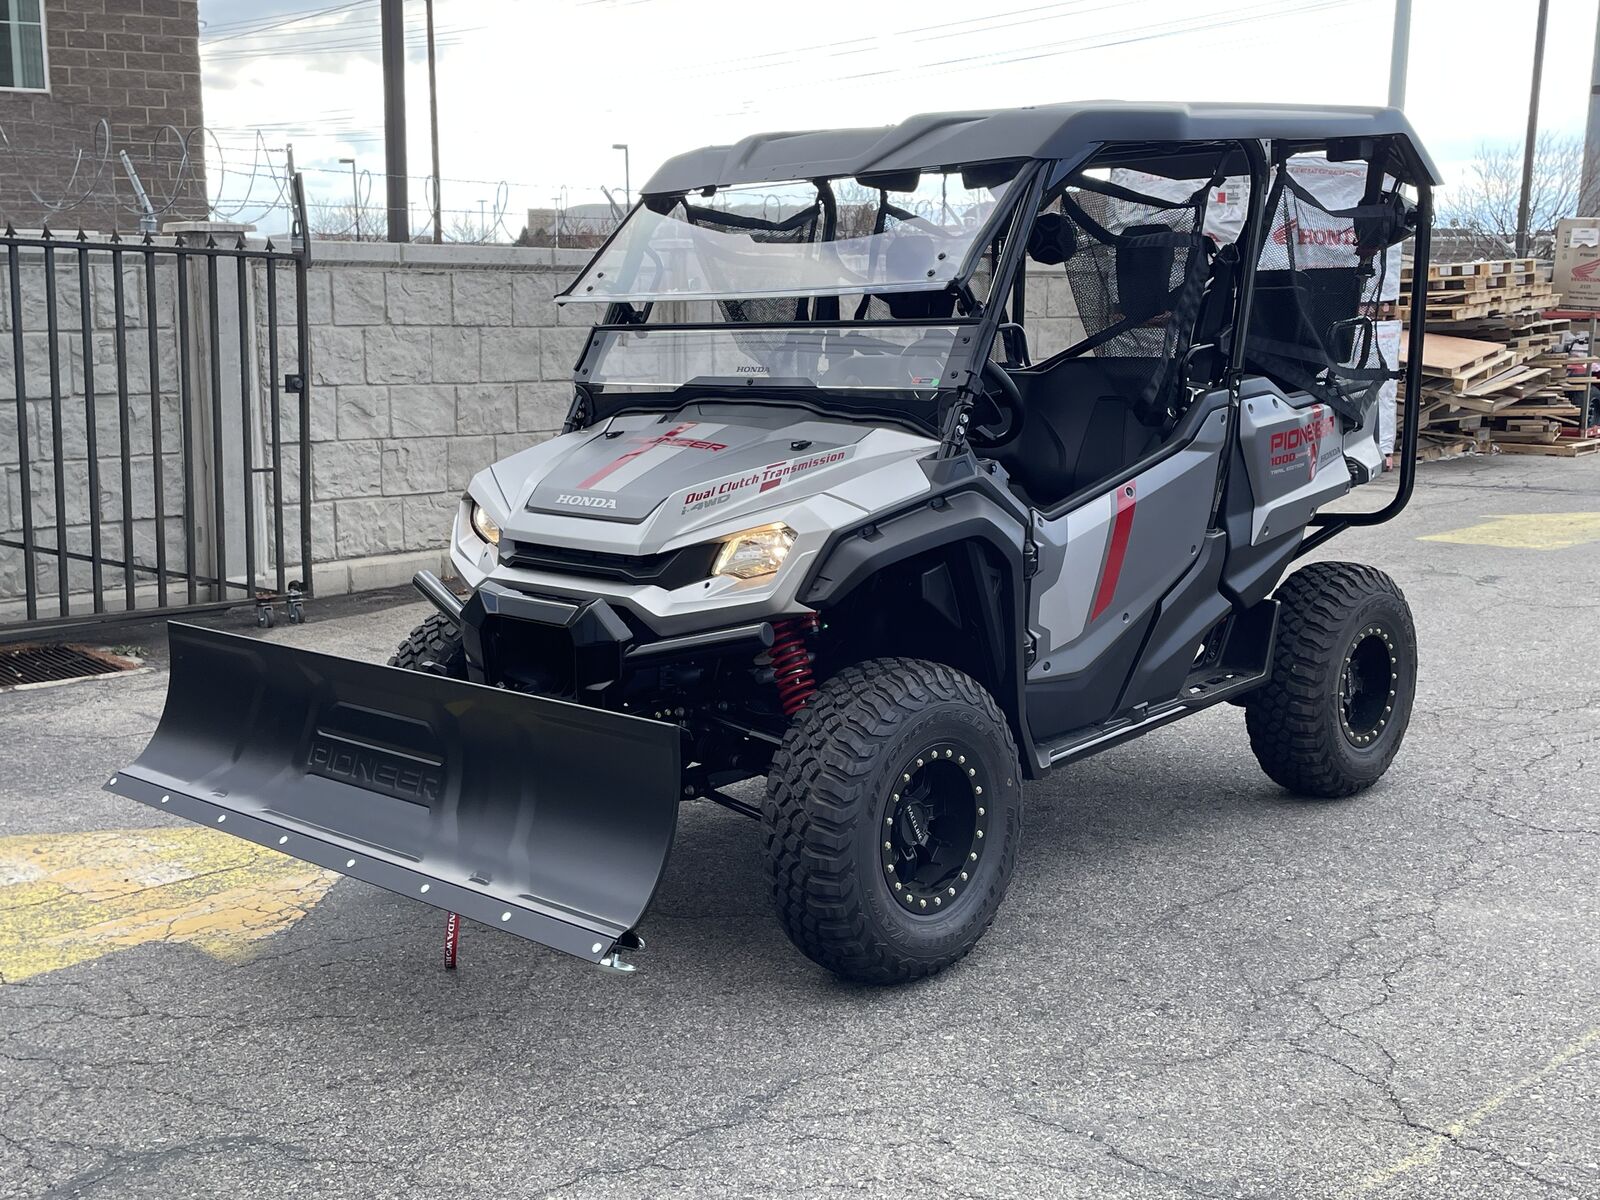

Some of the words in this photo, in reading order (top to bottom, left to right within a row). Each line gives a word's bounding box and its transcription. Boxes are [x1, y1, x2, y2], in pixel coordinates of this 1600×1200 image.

[1271, 453, 1296, 466] 1000
[684, 487, 715, 505] Dual
[719, 474, 759, 494] Clutch
[762, 451, 845, 481] Transmission
[555, 494, 617, 509] HONDA
[307, 741, 440, 801] PIONEER
